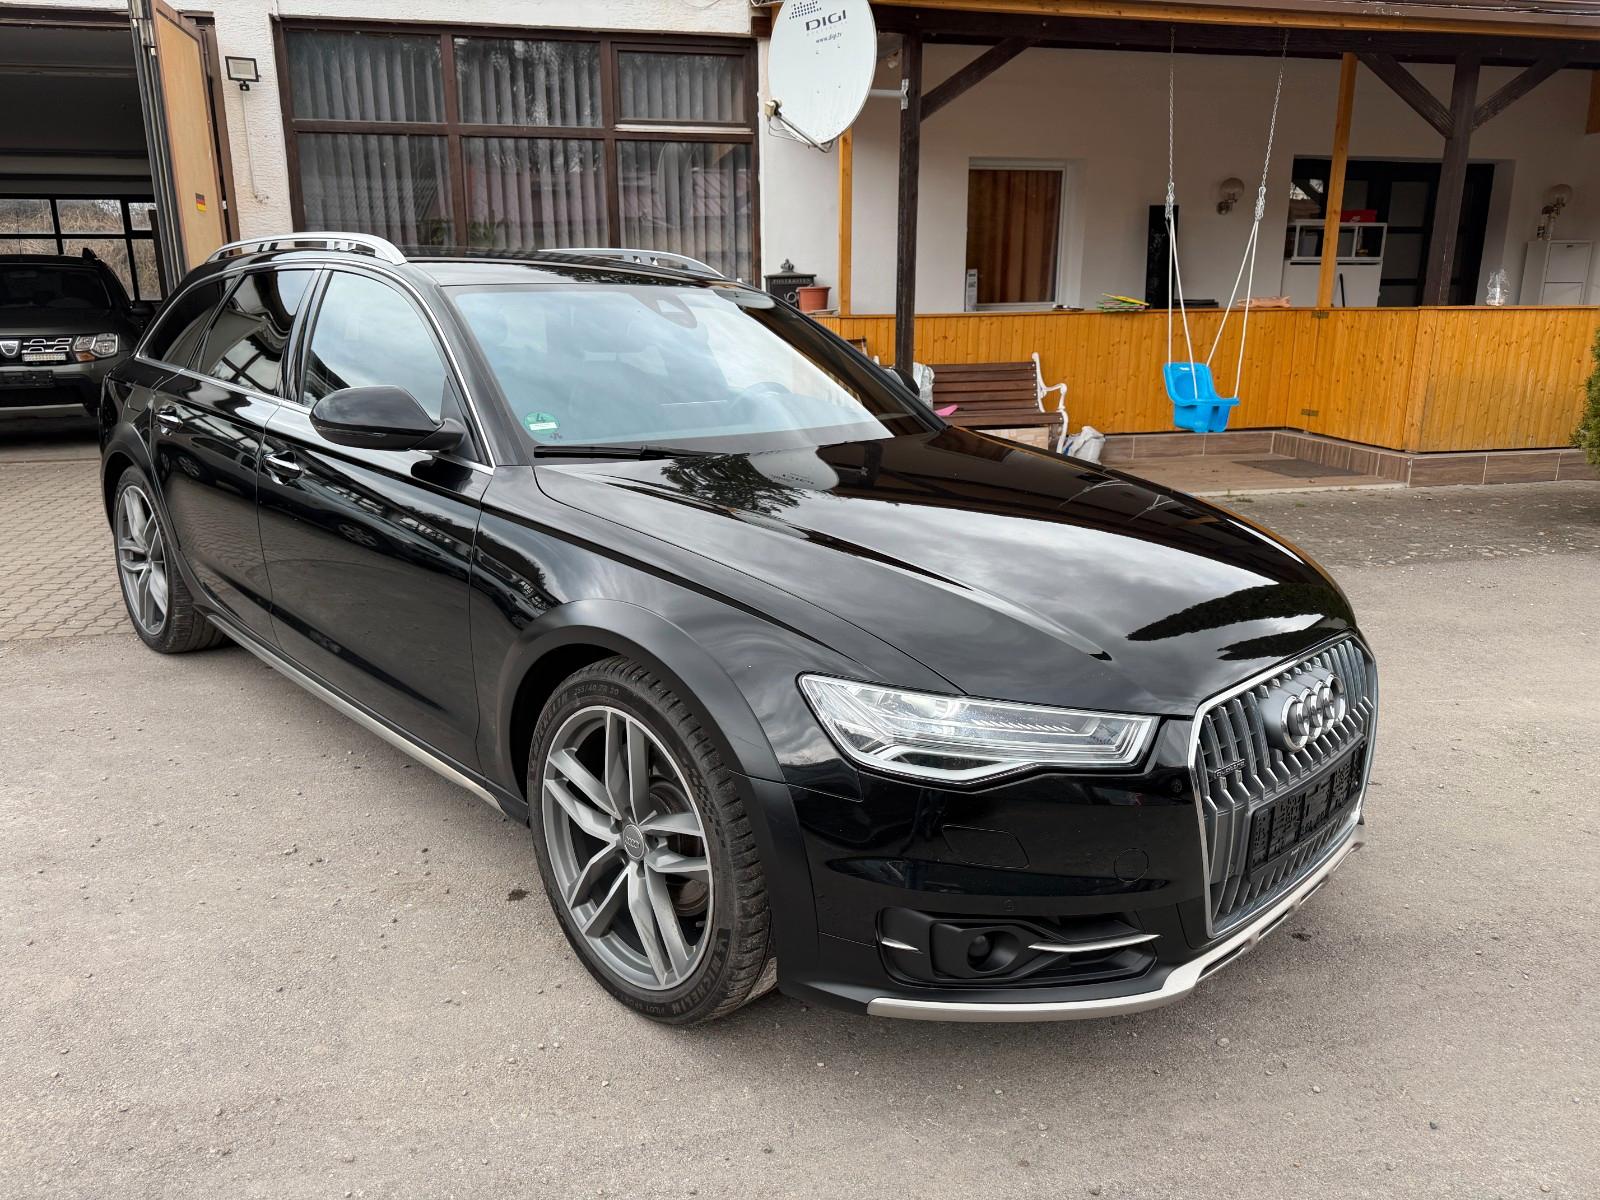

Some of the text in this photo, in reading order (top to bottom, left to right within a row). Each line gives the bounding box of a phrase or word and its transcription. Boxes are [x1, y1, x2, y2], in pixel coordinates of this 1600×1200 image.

[805, 9, 847, 31] DIGI
[1216, 761, 1245, 777] quattro
[670, 953, 722, 1015] MICHELIN
[645, 1004, 666, 1014] PILOT
